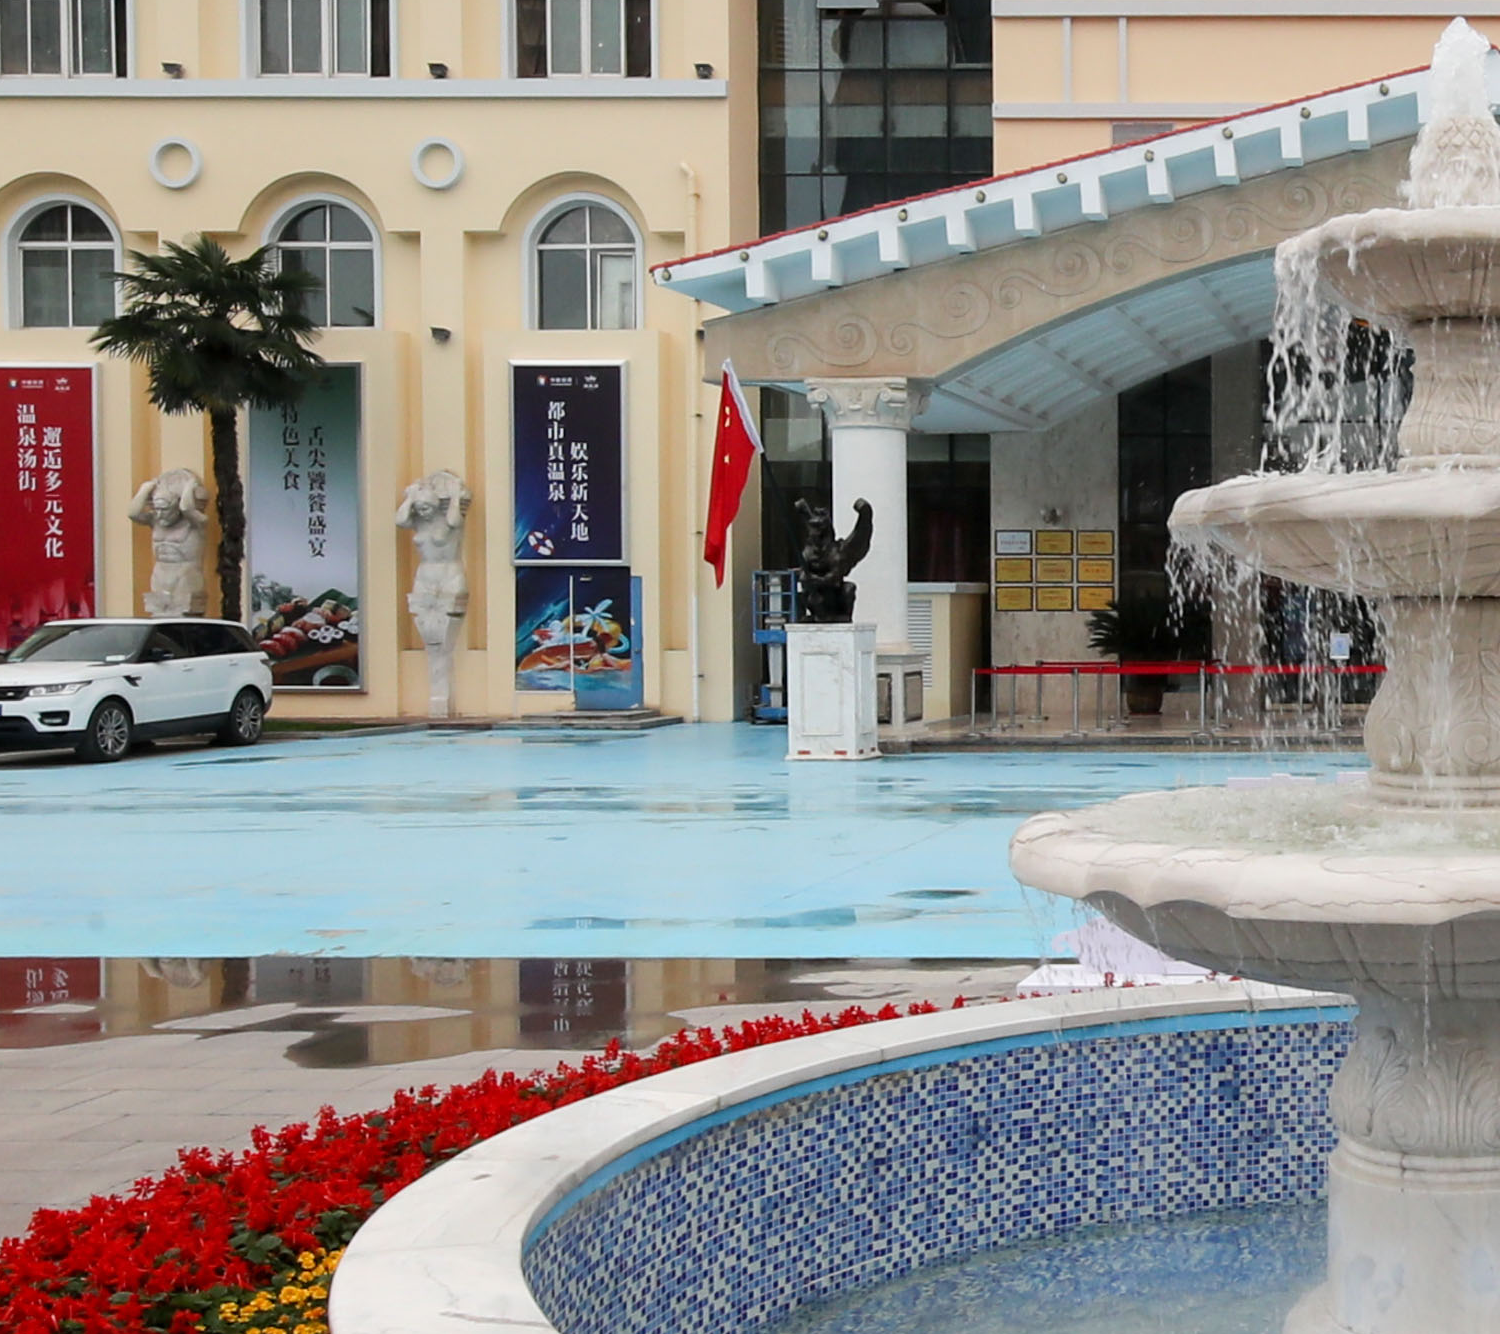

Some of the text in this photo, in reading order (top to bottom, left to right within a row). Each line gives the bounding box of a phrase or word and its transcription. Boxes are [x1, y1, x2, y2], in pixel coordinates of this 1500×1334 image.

[17, 403, 37, 492] 温泉汤街
[42, 426, 64, 559] 邂逅多元文化
[547, 400, 566, 502] 都市真温泉
[570, 441, 589, 542] 娱乐新天地
